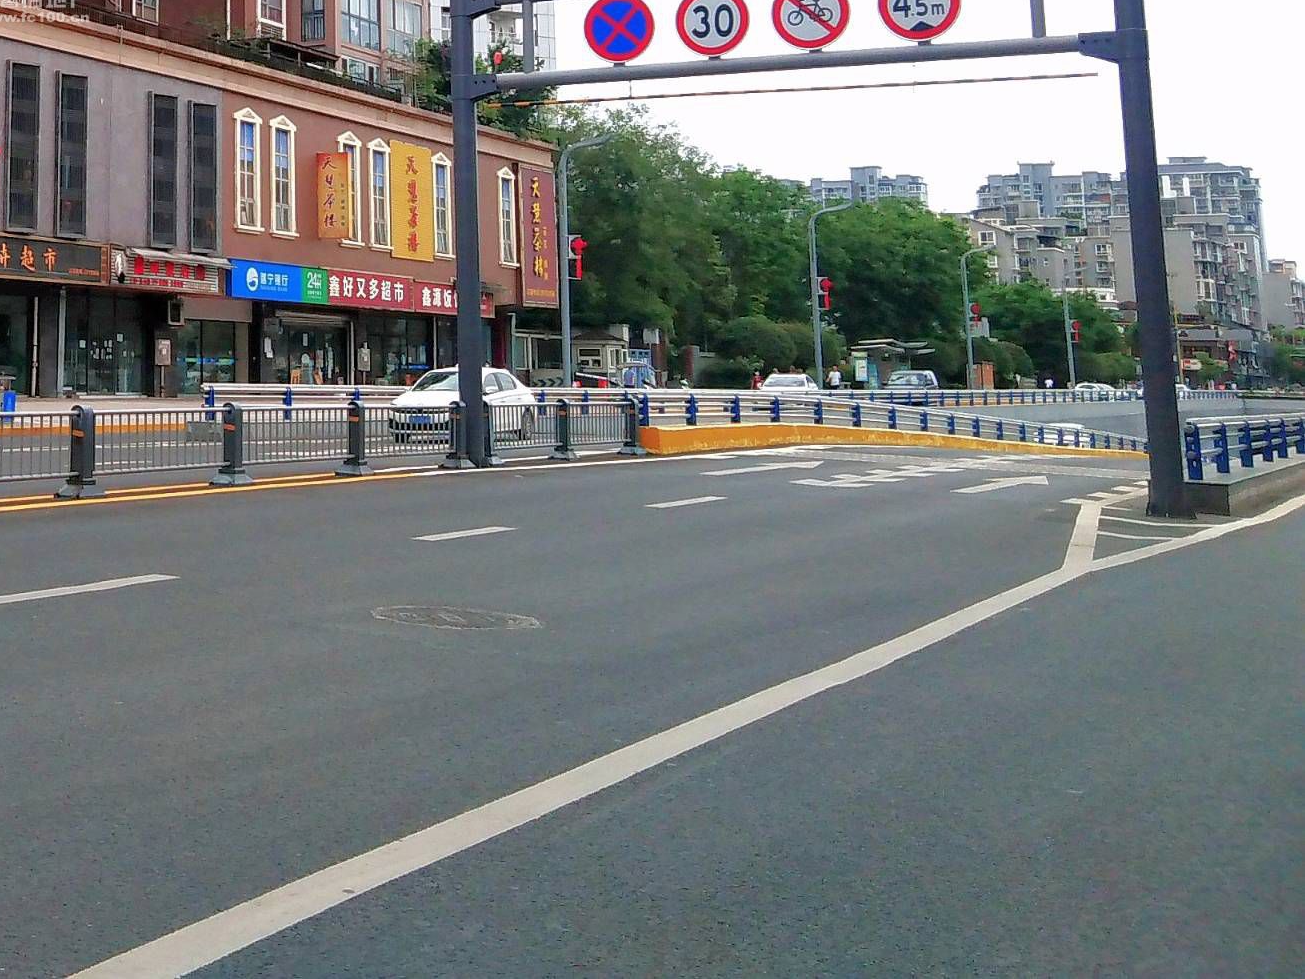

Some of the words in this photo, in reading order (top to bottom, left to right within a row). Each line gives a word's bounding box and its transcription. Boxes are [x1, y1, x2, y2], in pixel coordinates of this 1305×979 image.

[691, 4, 734, 38] 30
[329, 275, 404, 303] 鑫好又多超市
